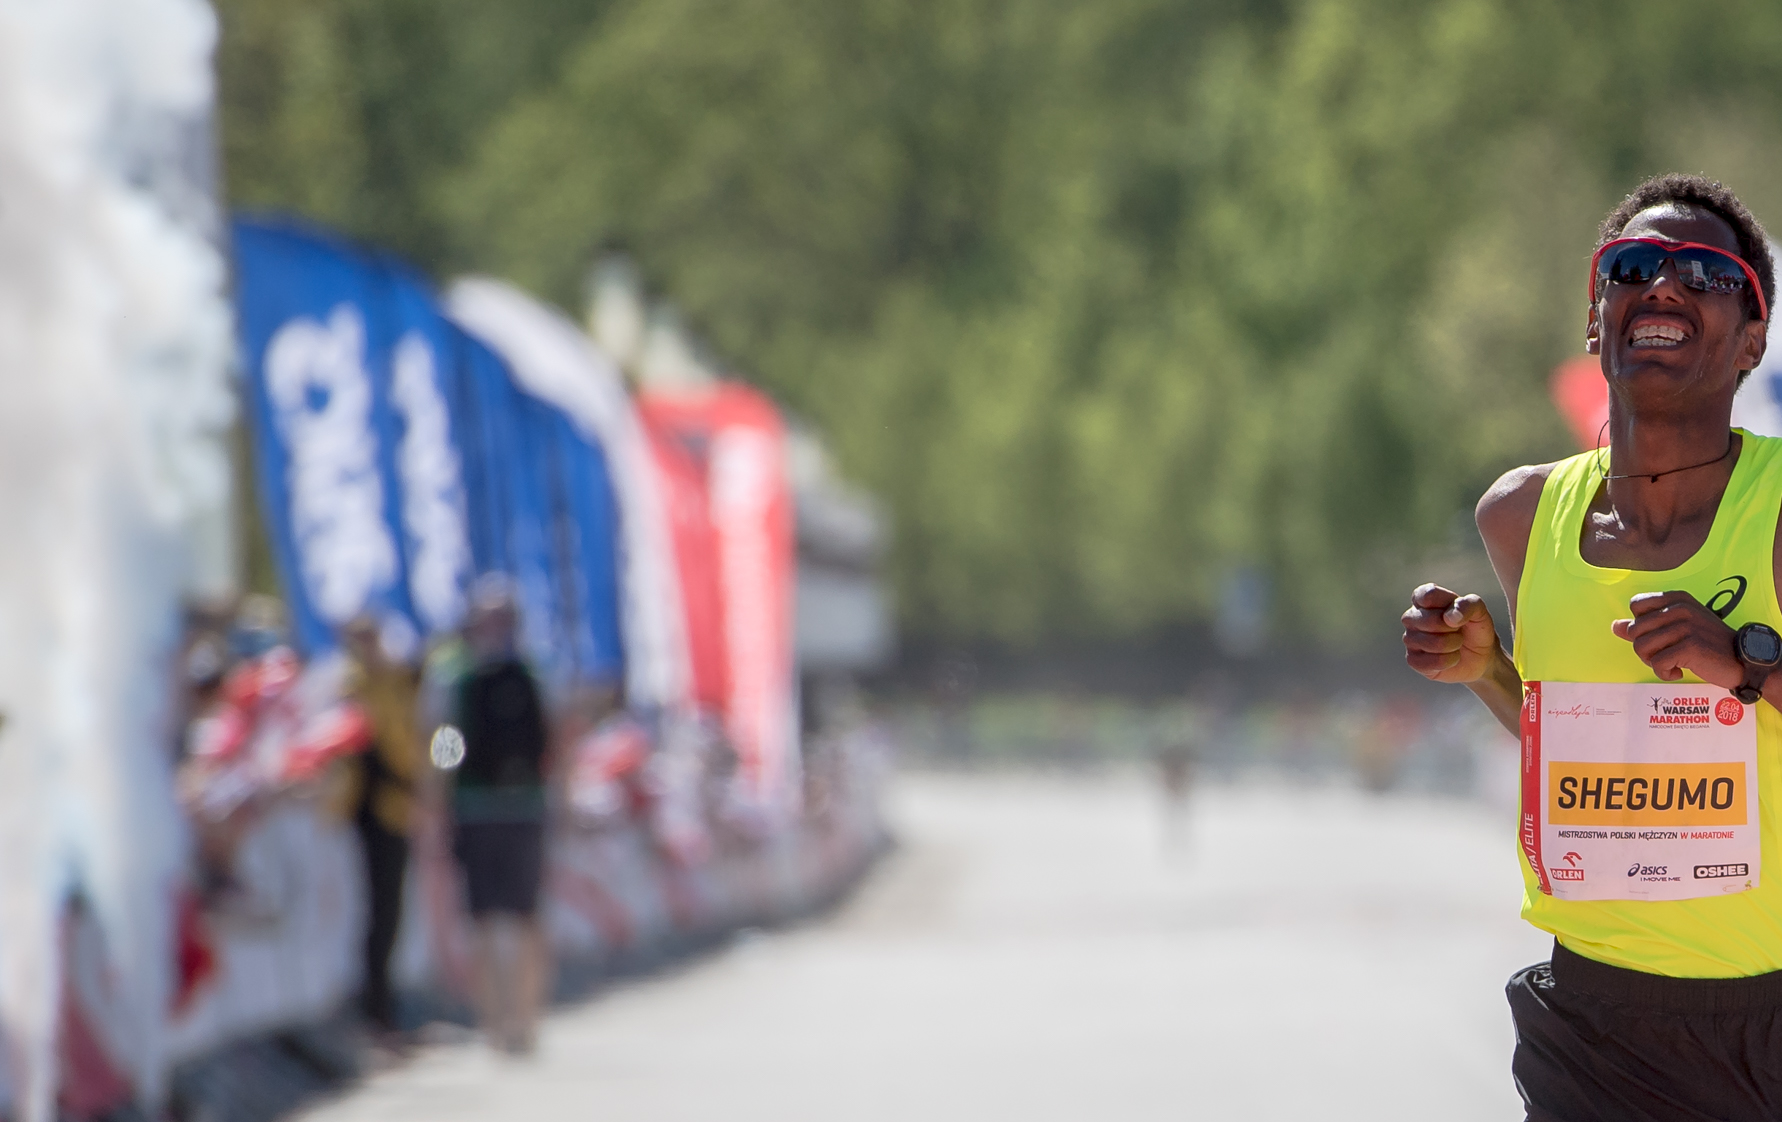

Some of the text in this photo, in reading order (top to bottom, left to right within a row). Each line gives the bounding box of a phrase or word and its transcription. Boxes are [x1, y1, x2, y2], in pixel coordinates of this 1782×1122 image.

[1673, 697, 1709, 706] ORLEN
[1663, 706, 1710, 715] WARSAW
[1718, 709, 1739, 722] 2018
[1649, 715, 1710, 724] MARATHON
[1558, 776, 1735, 811] SHEGUMO
[1525, 812, 1534, 846] ELITE
[1558, 829, 1735, 841] MISTRZOSTWA POLSKI MĘŻCZYZN W MARATONIE
[1552, 869, 1582, 880] ORLEN
[1697, 866, 1746, 878] OSHEE
